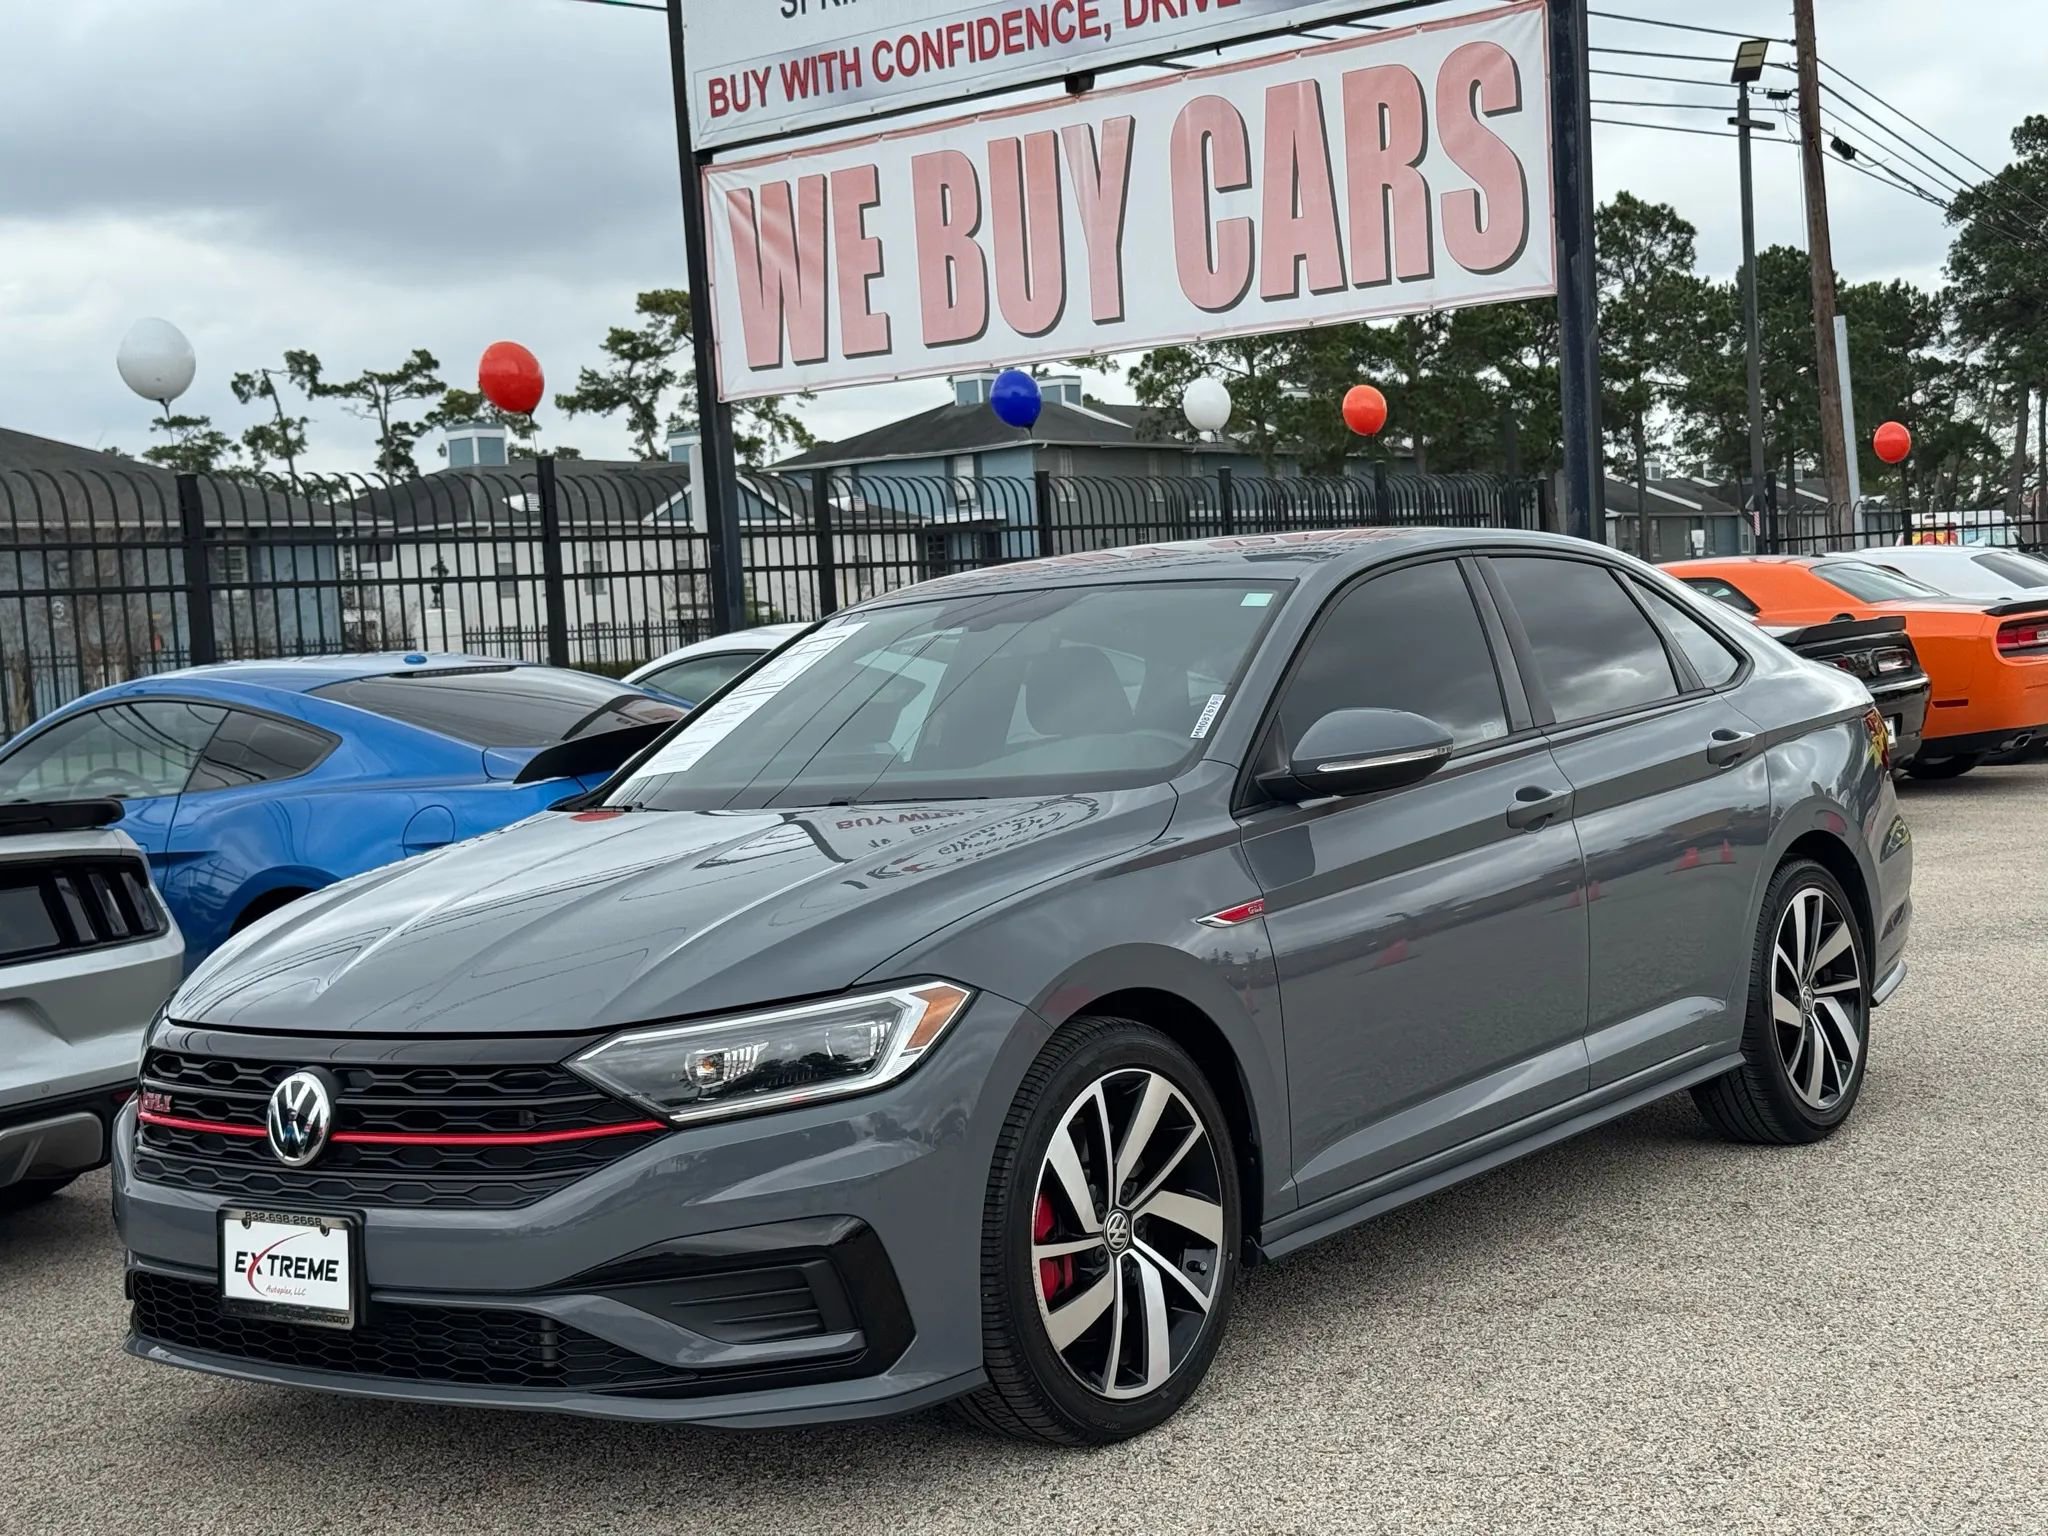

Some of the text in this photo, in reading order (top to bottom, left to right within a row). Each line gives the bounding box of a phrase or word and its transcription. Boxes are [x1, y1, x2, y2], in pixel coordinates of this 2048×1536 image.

[708, 0, 1241, 119] BUY WITH CONFIDENCE, DRI
[724, 41, 1529, 372] WE BUY CARS
[234, 1250, 340, 1282] EXTREME
